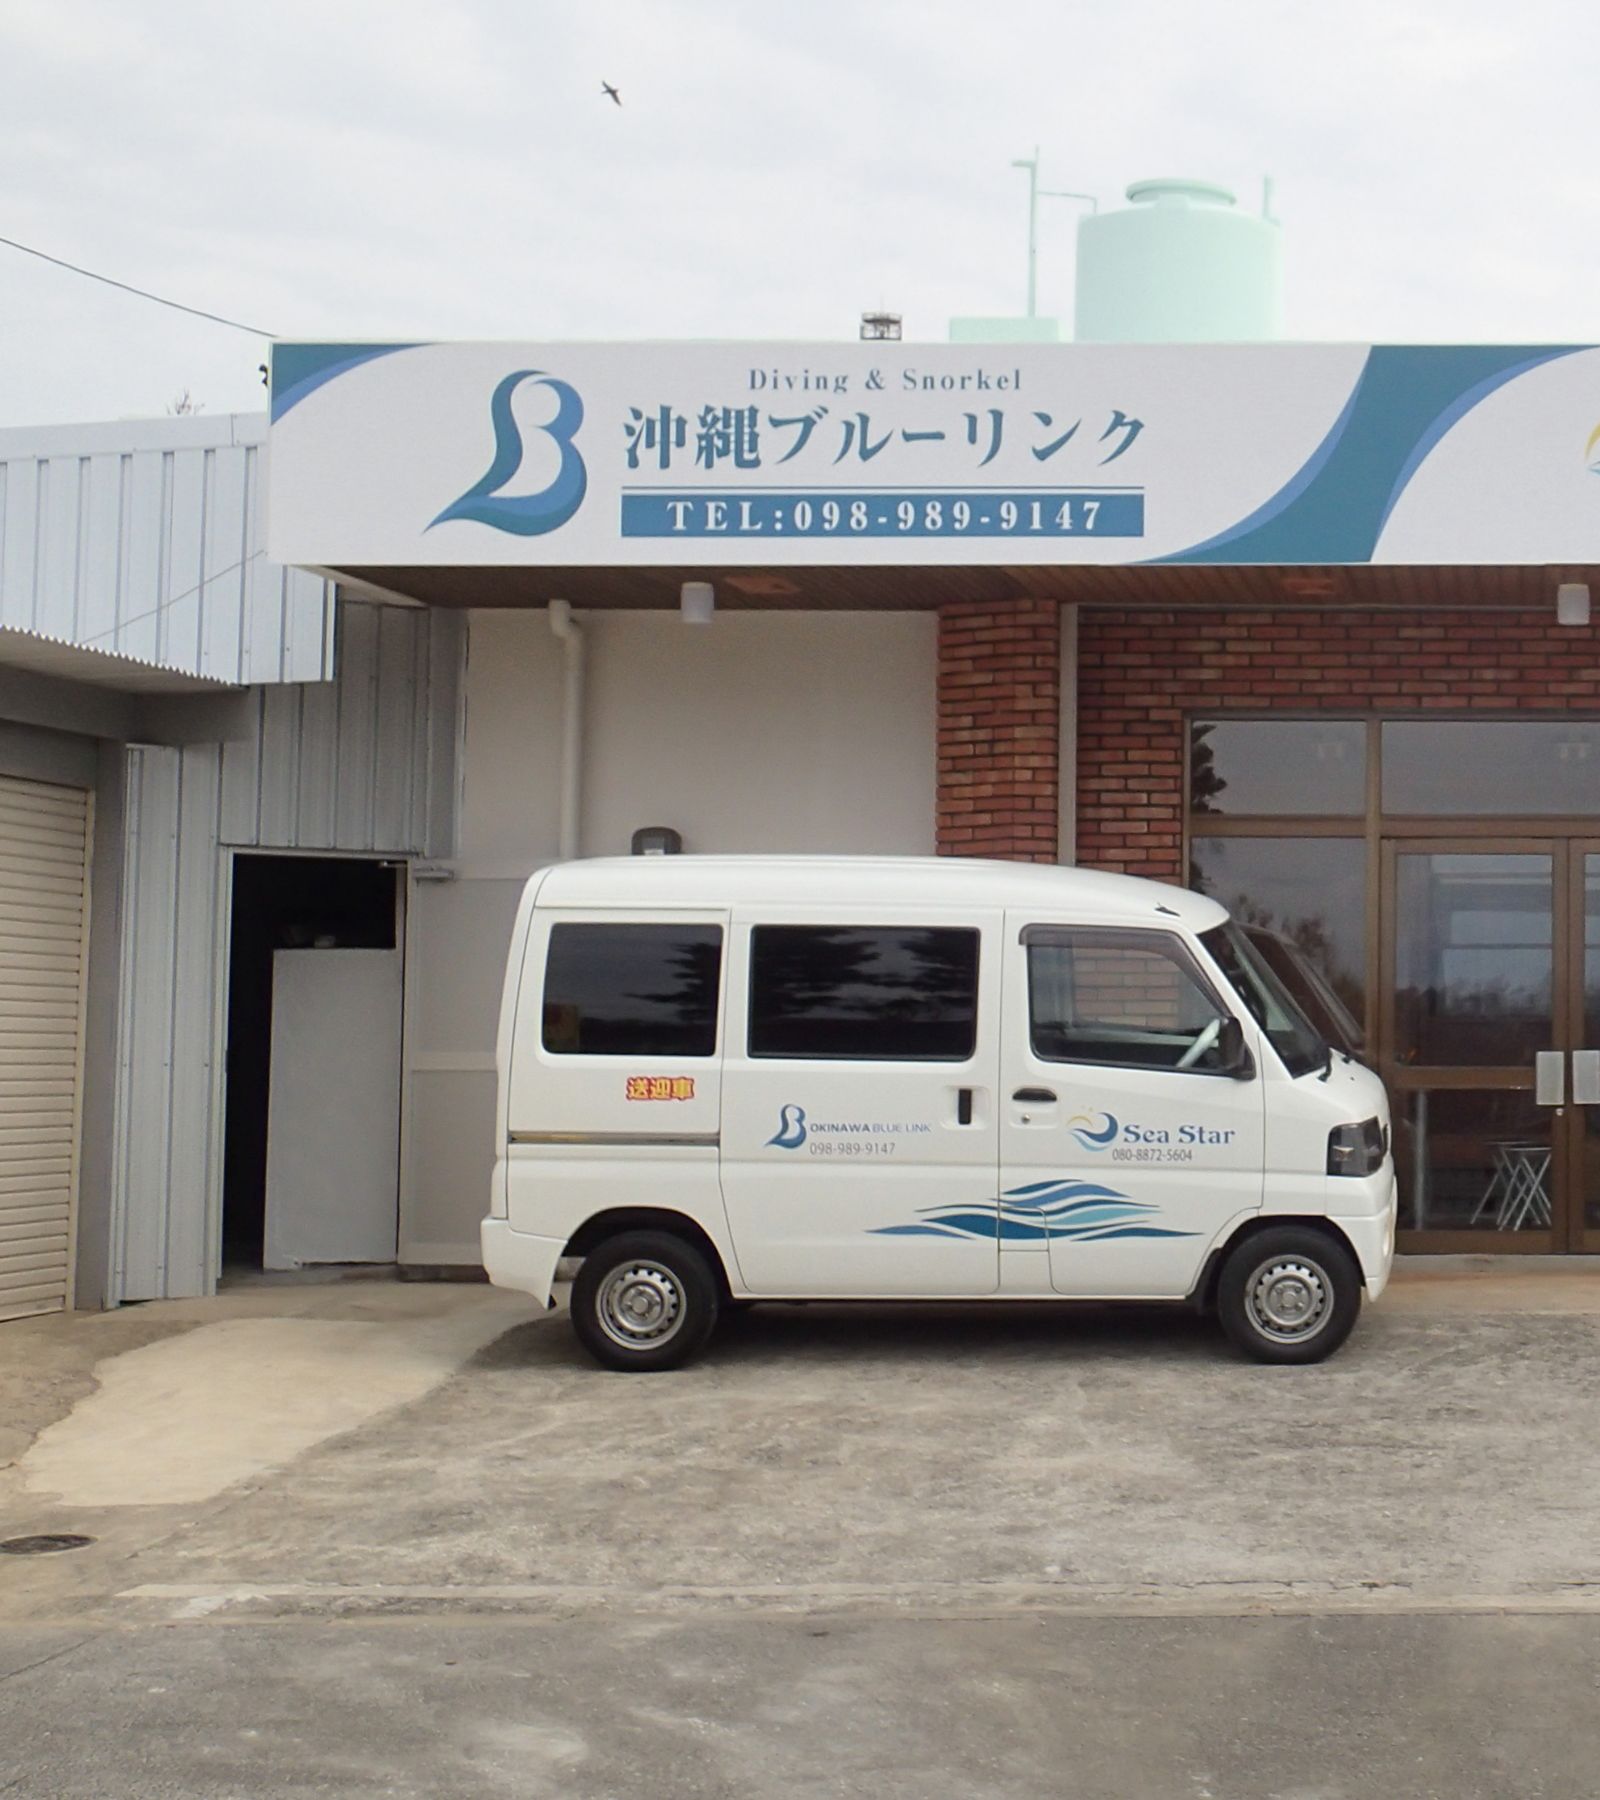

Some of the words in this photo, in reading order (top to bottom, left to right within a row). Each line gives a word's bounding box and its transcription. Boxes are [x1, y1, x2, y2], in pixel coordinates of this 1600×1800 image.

[749, 368, 848, 393] Diving
[864, 369, 885, 391] &
[902, 368, 1022, 391] Snorkel
[623, 404, 1145, 471] 沖縄ブルーリンク
[666, 500, 1102, 531] TEL:098-989-9147
[626, 1076, 695, 1101] 送迎車
[809, 1123, 871, 1133] OKINAWA
[872, 1123, 903, 1133] BLUE
[905, 1123, 932, 1133] LINK
[1122, 1124, 1170, 1144] Sea
[1177, 1124, 1236, 1145] Star
[809, 1142, 896, 1156] 098-989-9147
[1112, 1148, 1193, 1162] 080-8872-5604
